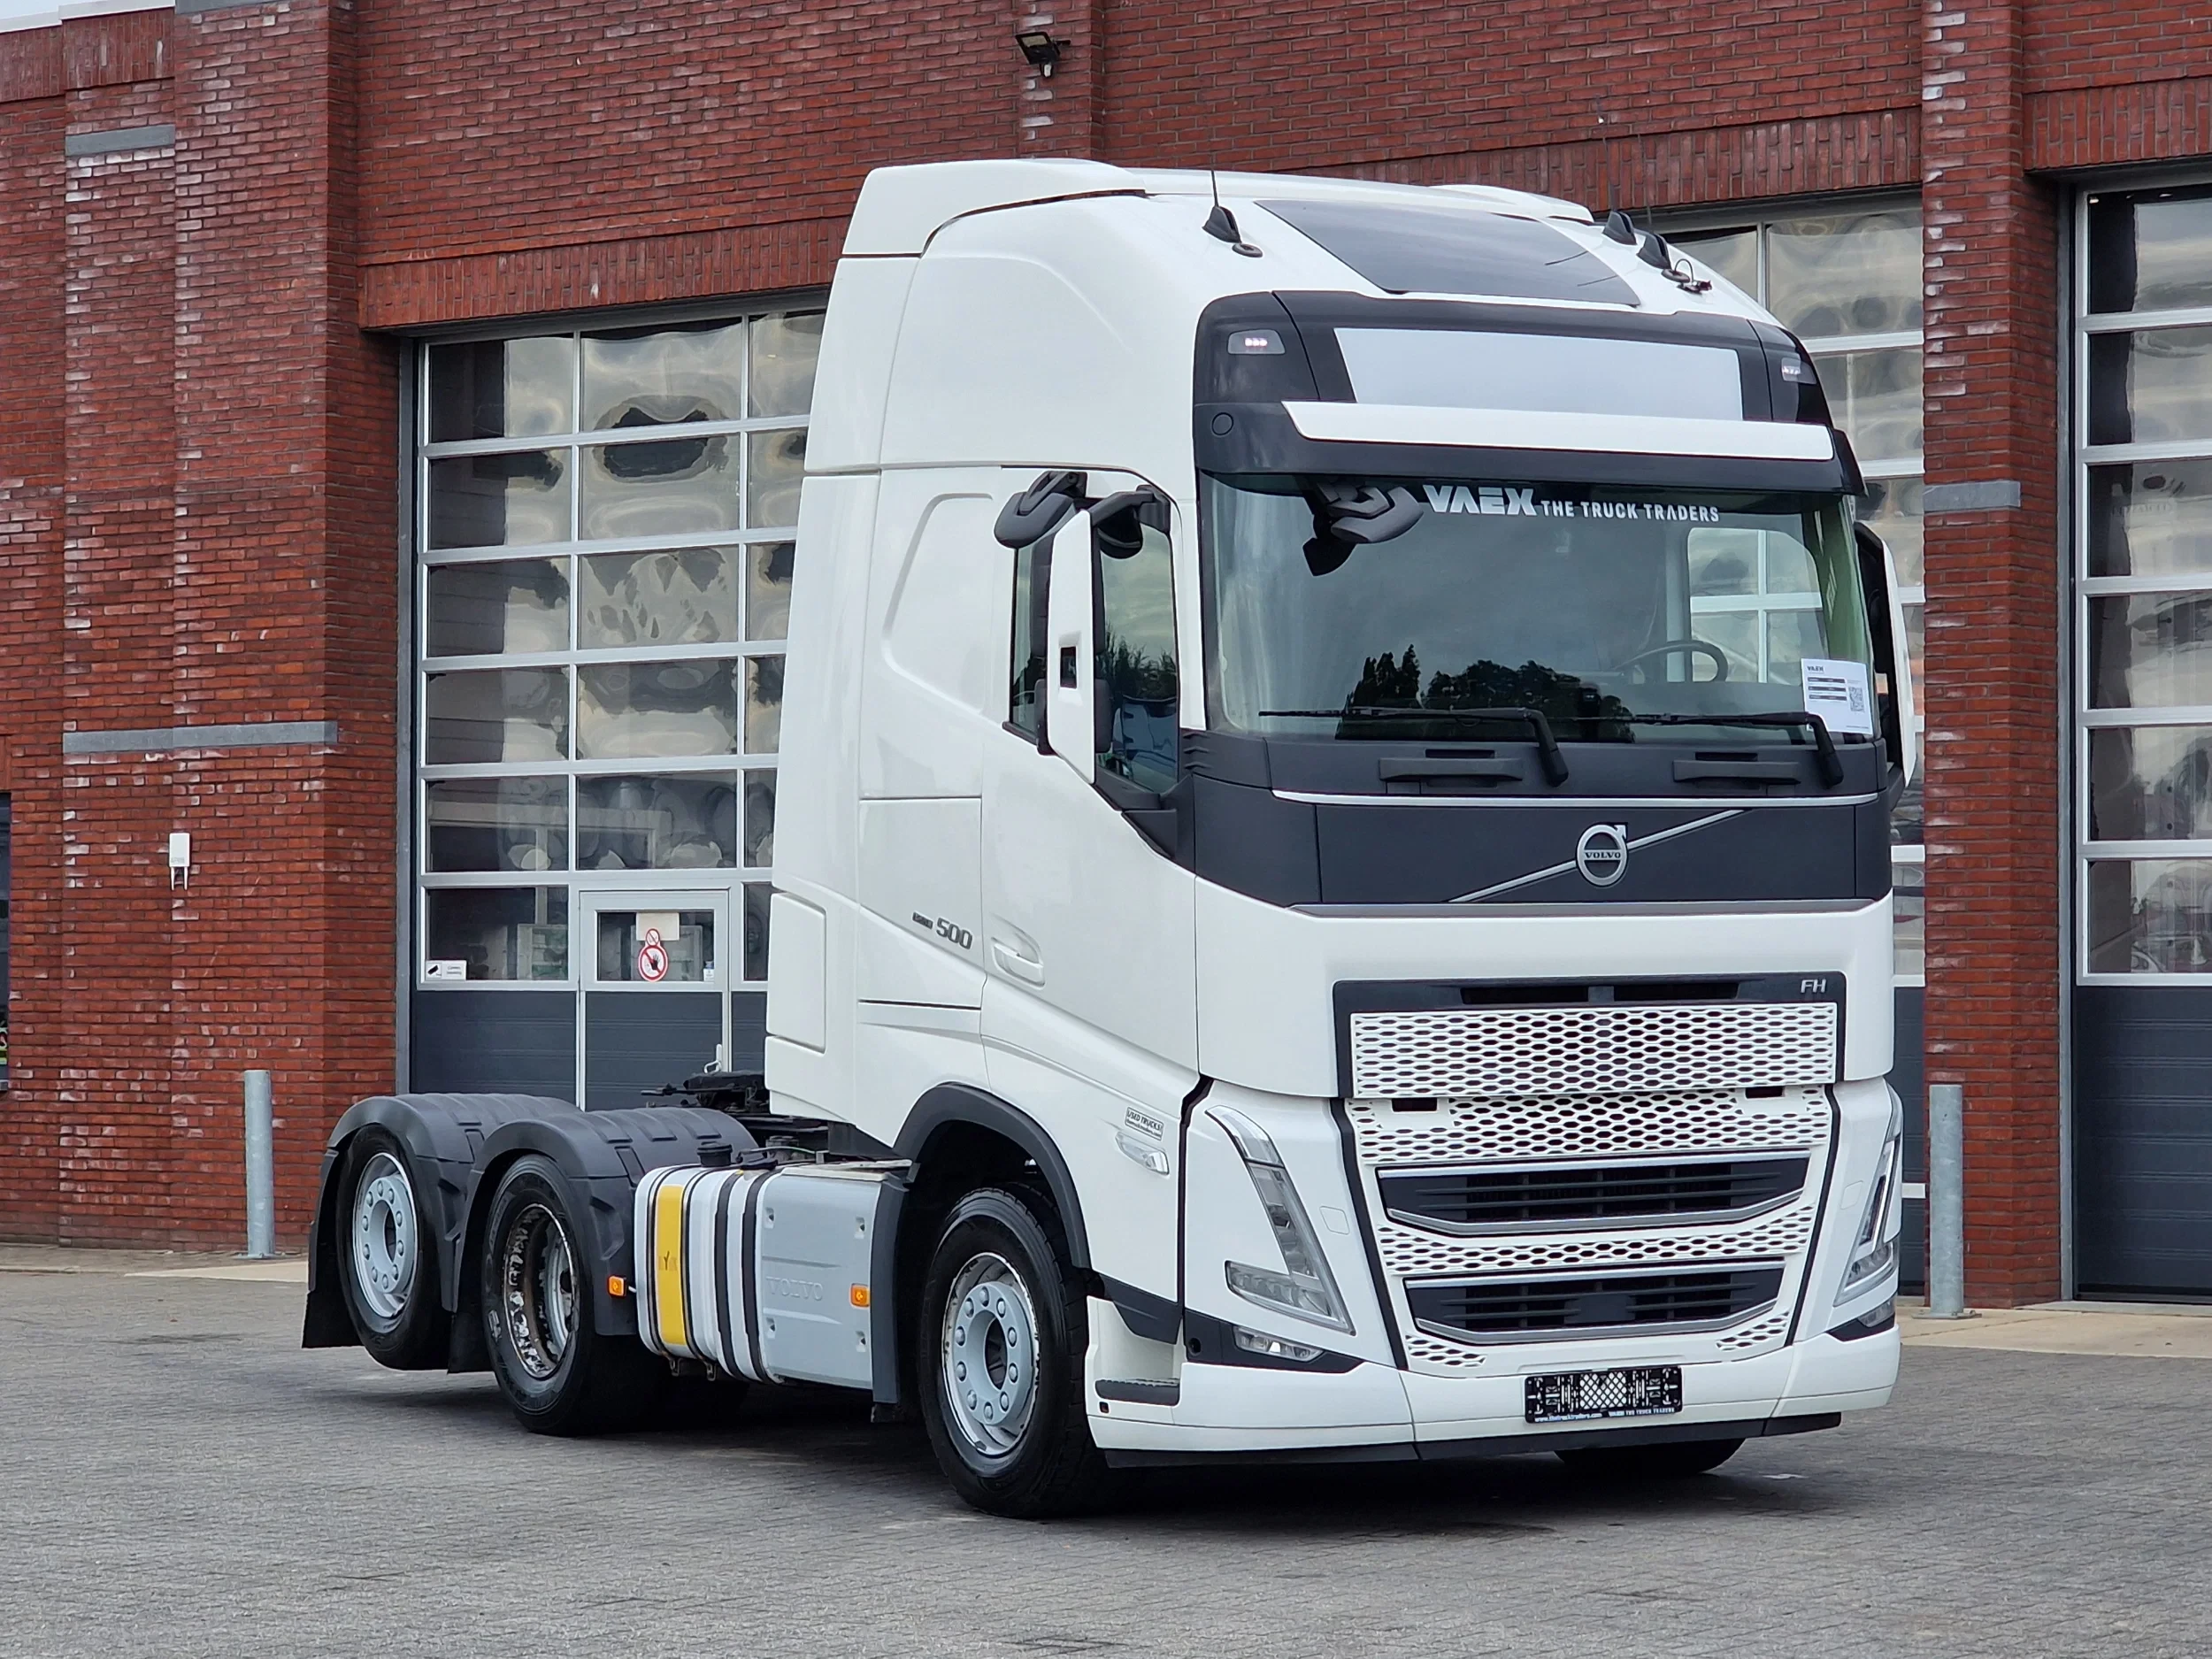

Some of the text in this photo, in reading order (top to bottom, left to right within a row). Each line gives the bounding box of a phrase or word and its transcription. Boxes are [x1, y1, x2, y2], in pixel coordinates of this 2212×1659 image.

[1423, 484, 1719, 522] VAEX THE TRUCK TRADERS
[936, 917, 973, 950] 500
[1801, 979, 1827, 993] FH
[765, 1276, 824, 1302] VOLVO
